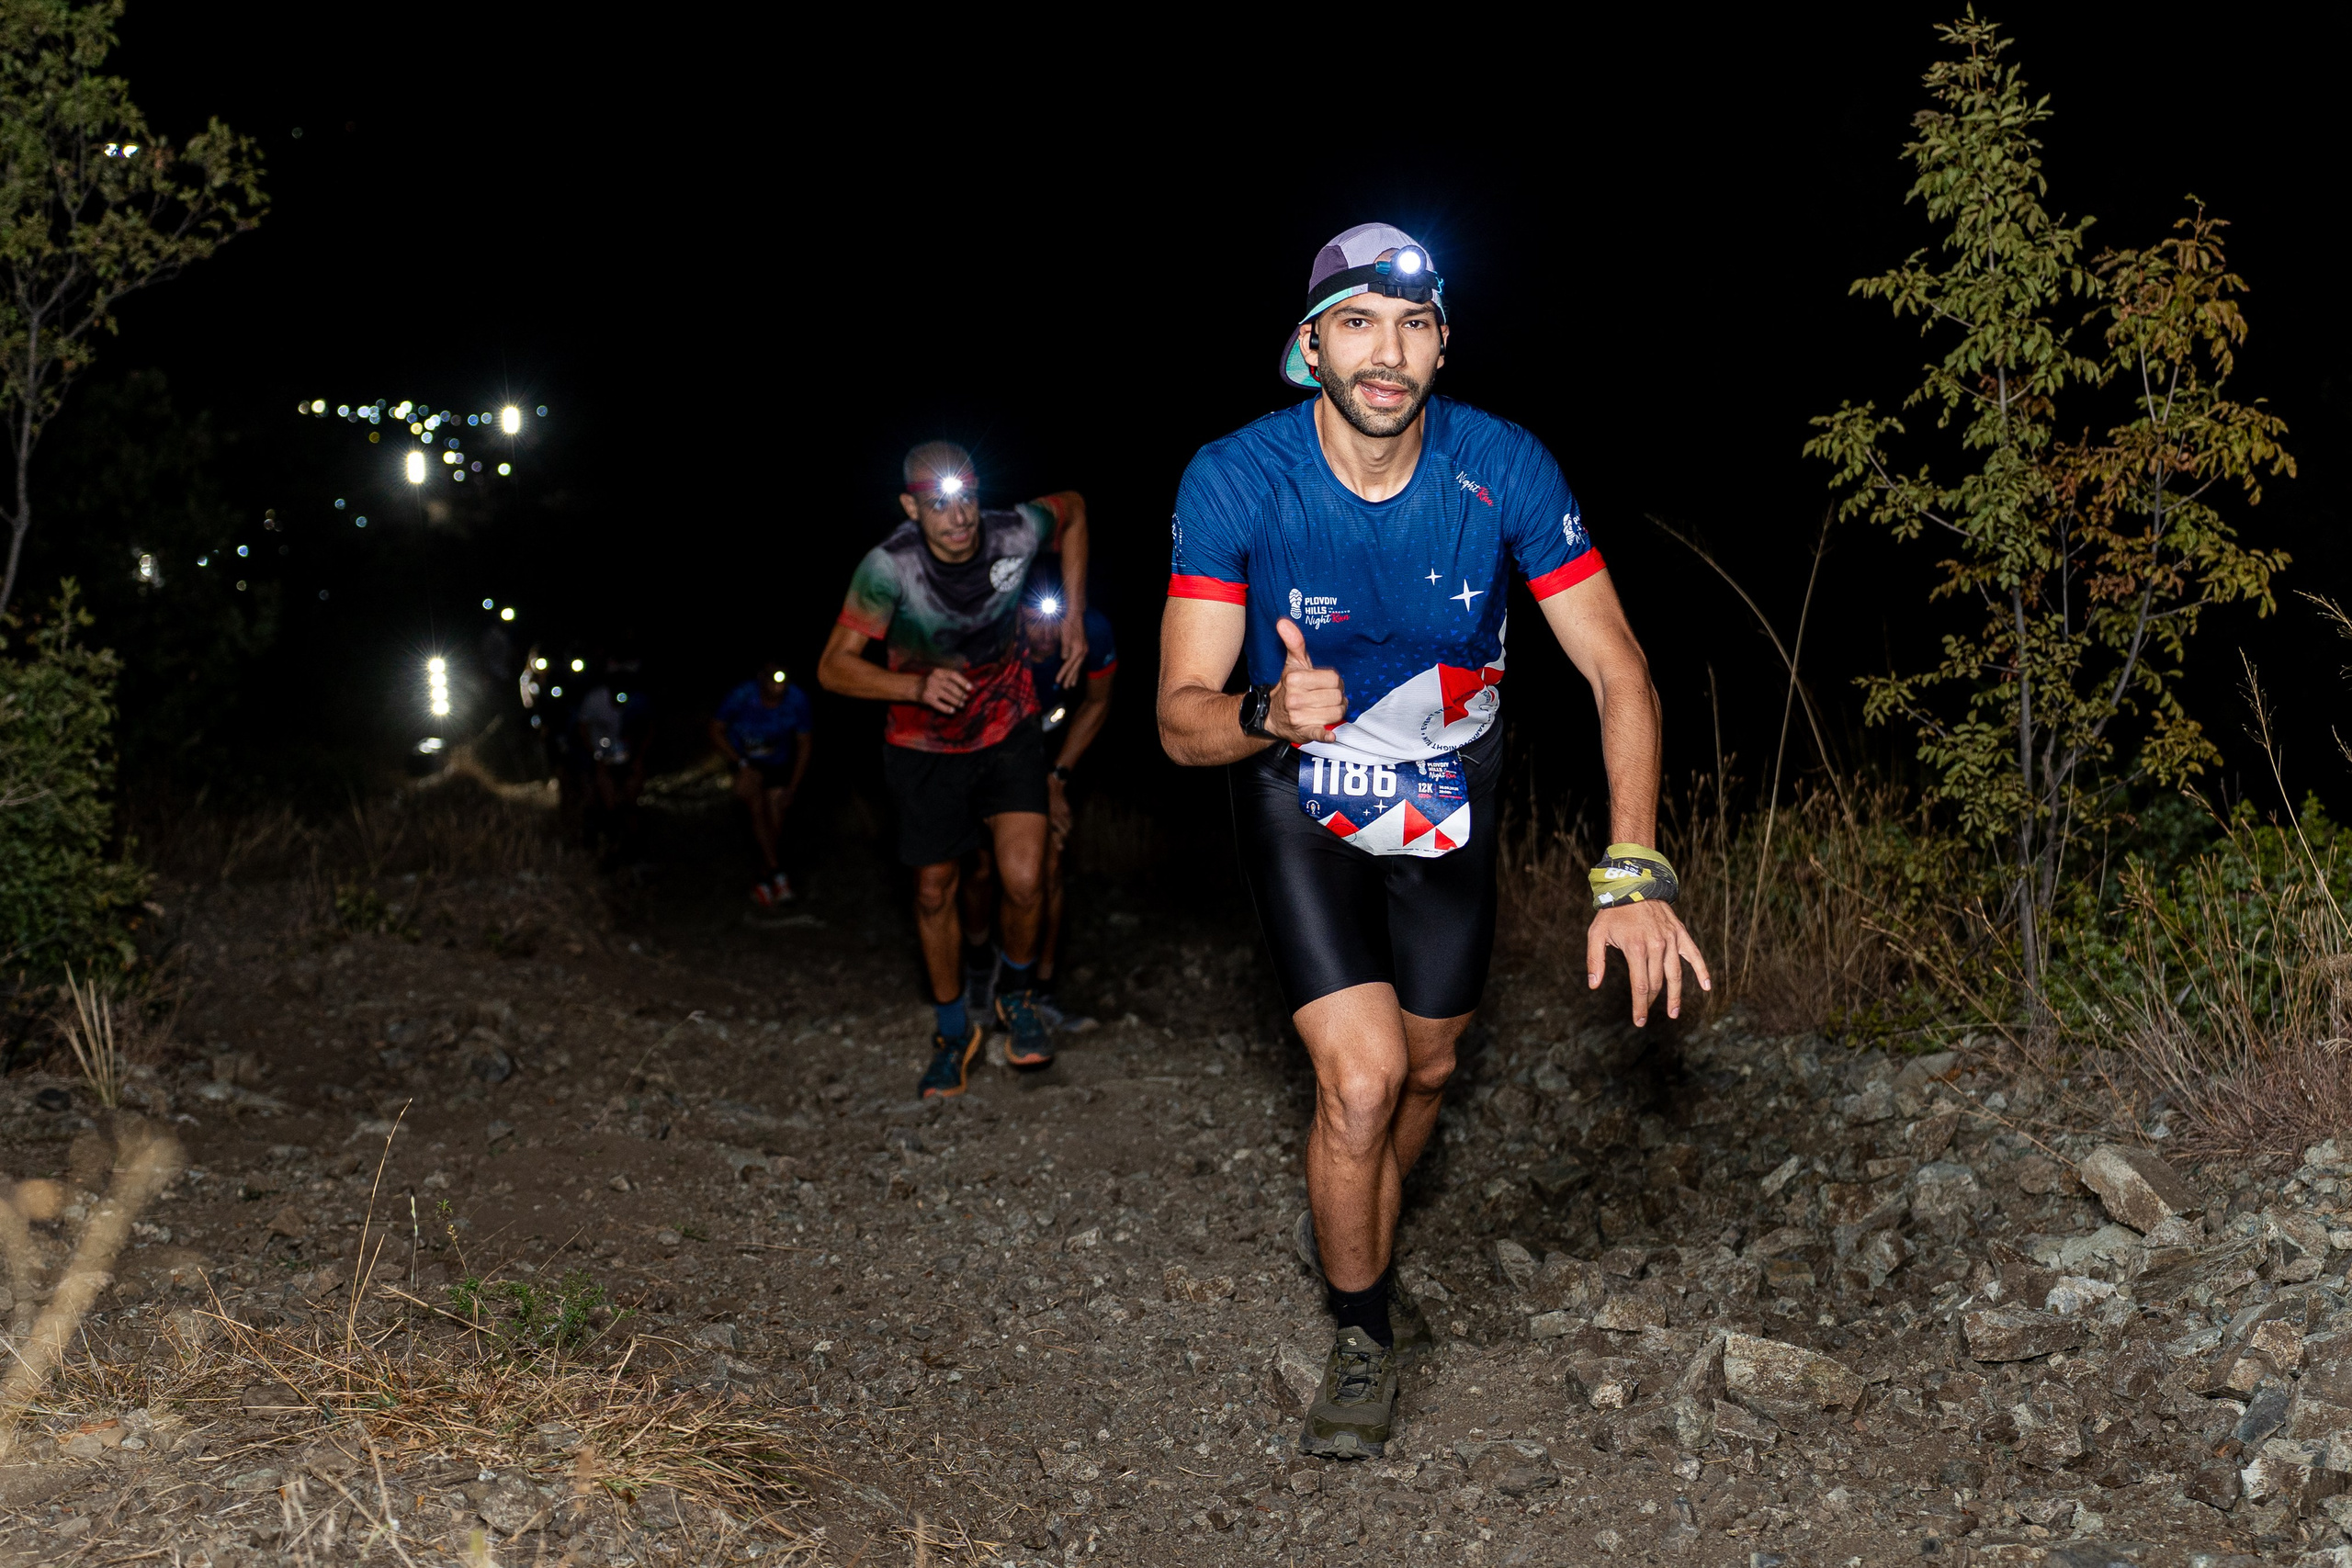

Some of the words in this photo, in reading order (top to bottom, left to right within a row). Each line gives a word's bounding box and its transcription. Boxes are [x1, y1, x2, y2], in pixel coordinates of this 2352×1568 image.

[1455, 470, 1481, 493] Night
[1305, 597, 1337, 605] PLOVDIV
[1305, 606, 1327, 615] HILLS
[1305, 615, 1331, 630] Night
[1330, 613, 1350, 623] Run
[1431, 743, 1457, 751] NIGHT
[1311, 757, 1397, 798] 1186
[1429, 772, 1446, 782] Night
[1418, 783, 1433, 794] 12K
